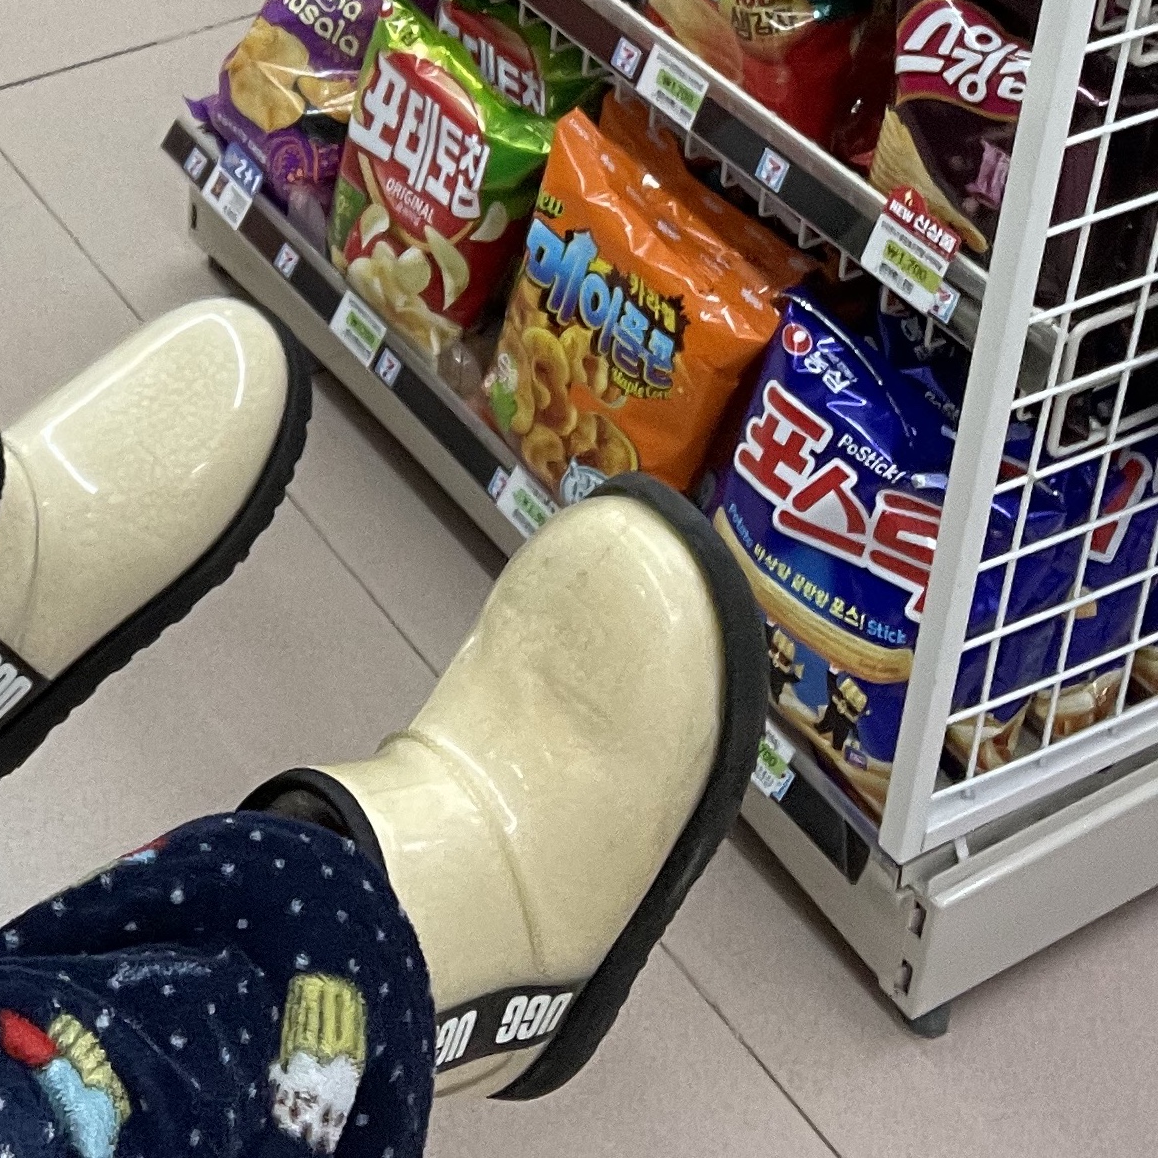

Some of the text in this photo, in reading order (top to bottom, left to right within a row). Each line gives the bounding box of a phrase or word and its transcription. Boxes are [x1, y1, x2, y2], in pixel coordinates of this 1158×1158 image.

[348, 55, 491, 220] 포테토칩
[234, 162, 260, 190] 2+1
[385, 177, 434, 225] ORIGINAL
[888, 199, 914, 223] NEW
[525, 217, 677, 392] 메이플콘
[866, 619, 908, 645] Stick
[435, 1009, 478, 1067] UG
[495, 992, 574, 1044] UGG
